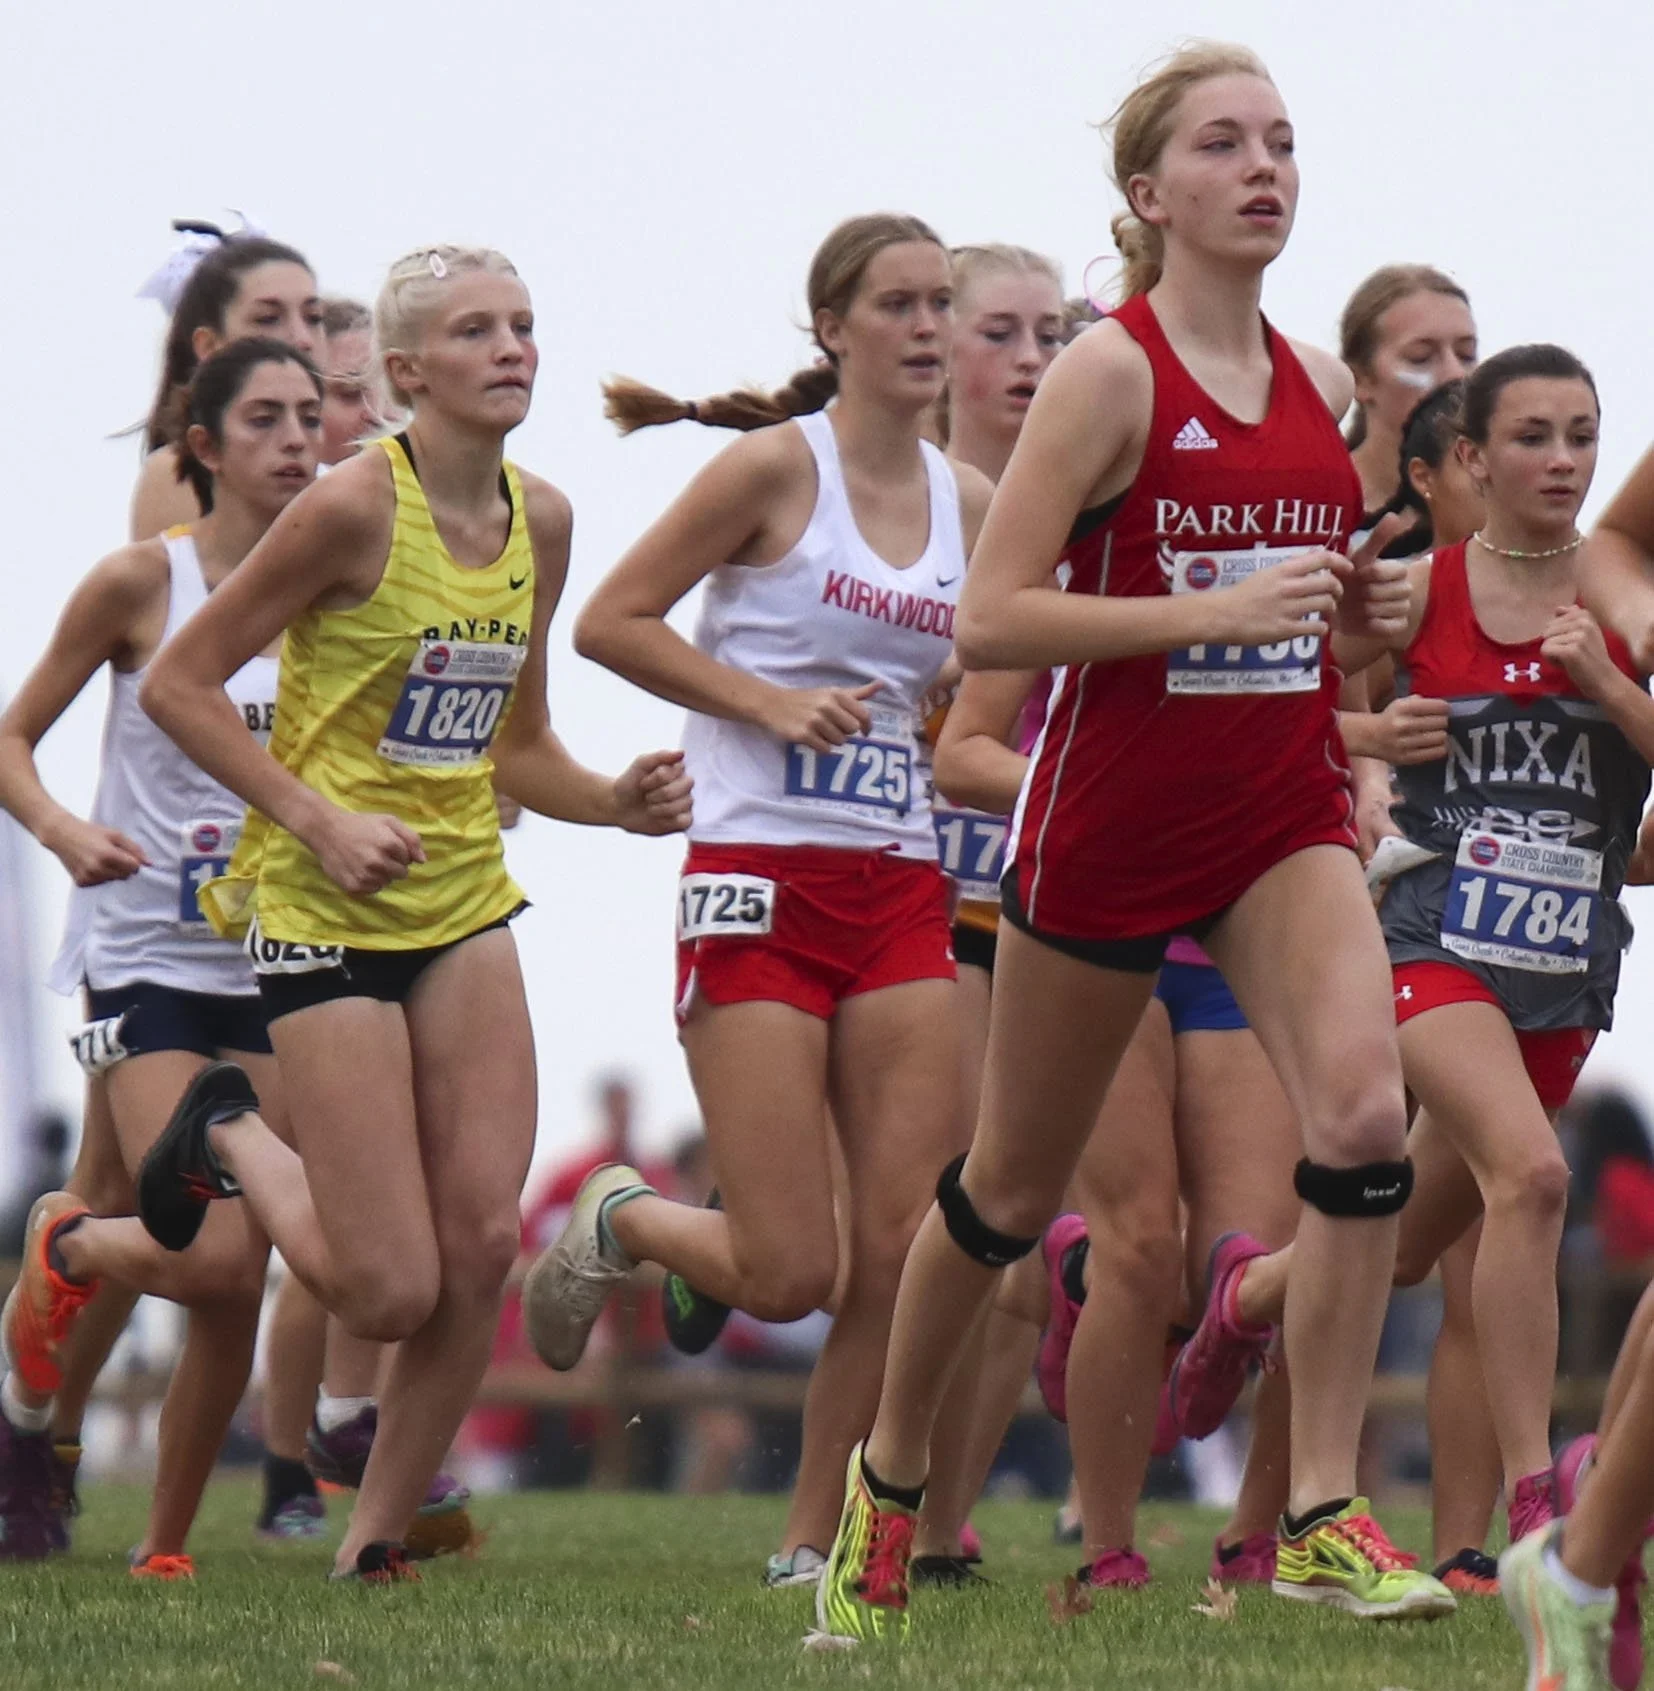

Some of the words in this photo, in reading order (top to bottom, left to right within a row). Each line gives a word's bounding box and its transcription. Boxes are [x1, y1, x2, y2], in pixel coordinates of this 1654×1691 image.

[1173, 437, 1218, 449] adidas
[404, 684, 504, 741] 1820
[793, 743, 908, 804] 1725
[1444, 720, 1597, 798] NIXA
[938, 818, 1004, 874] 17
[1504, 843, 1541, 861] CROSS
[681, 883, 766, 929] 1725
[1458, 876, 1593, 946] 1784
